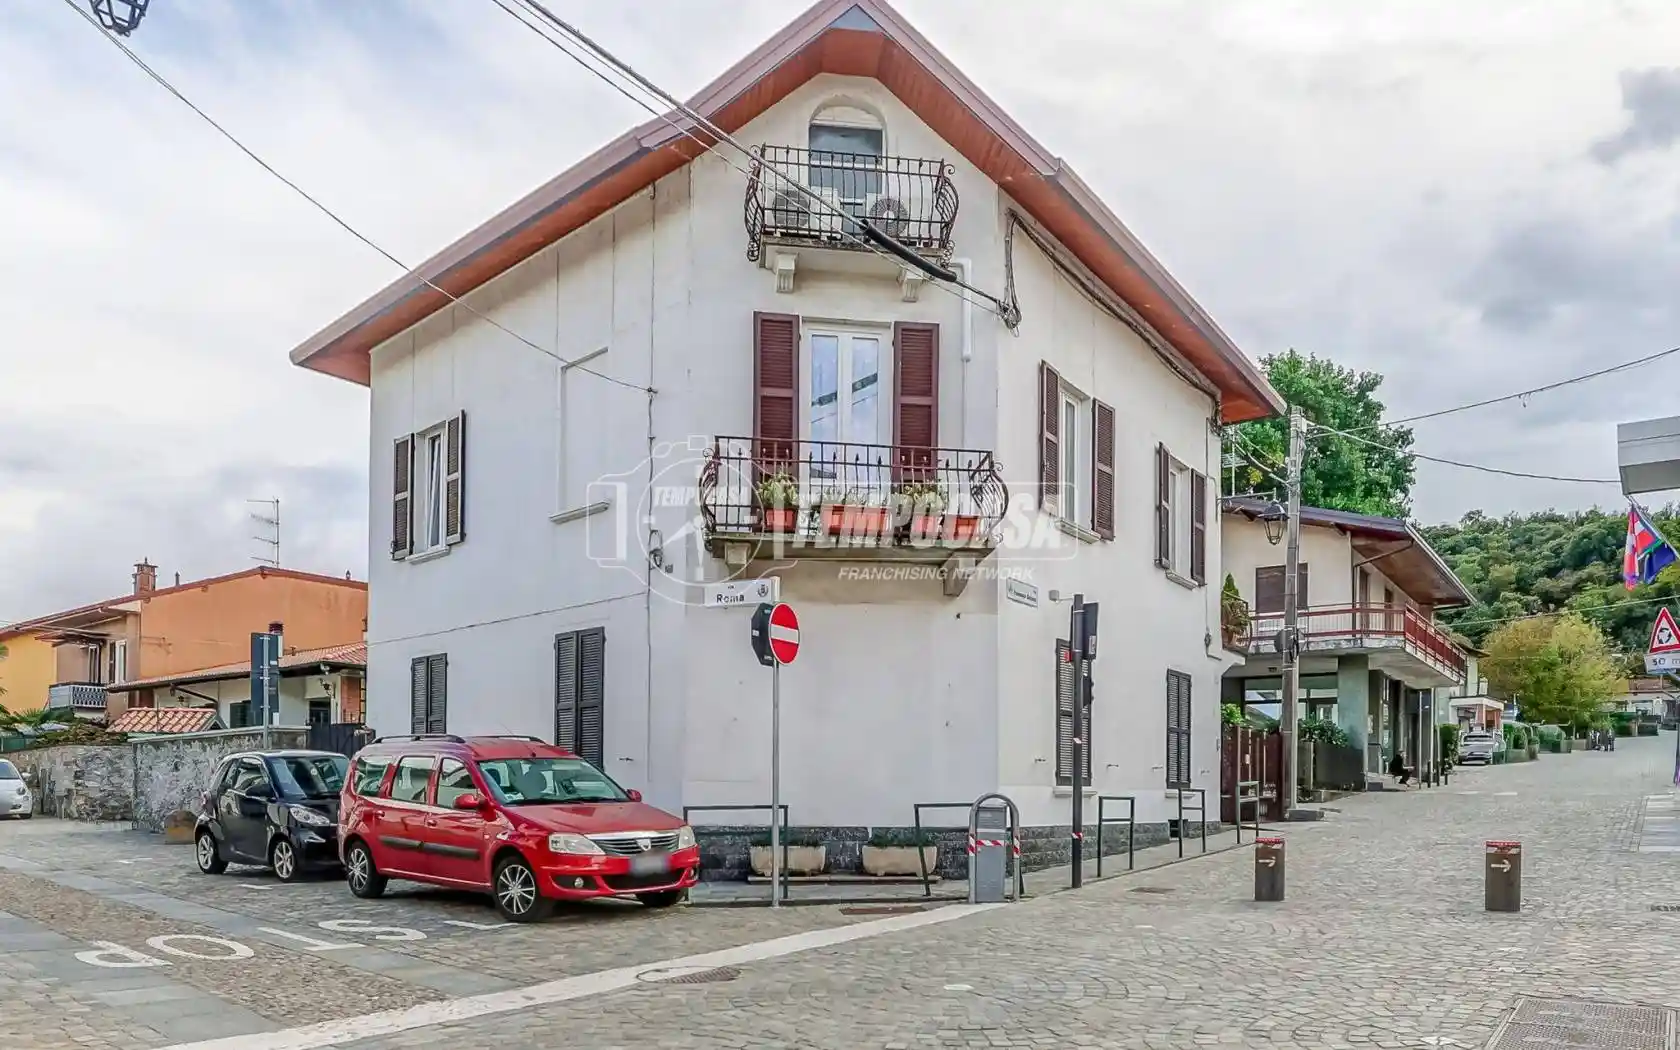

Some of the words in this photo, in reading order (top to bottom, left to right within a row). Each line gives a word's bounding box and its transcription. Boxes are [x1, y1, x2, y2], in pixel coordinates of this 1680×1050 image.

[717, 594, 745, 603] Roma
[1652, 657, 1666, 666] 50
[74, 919, 429, 968] STOP
